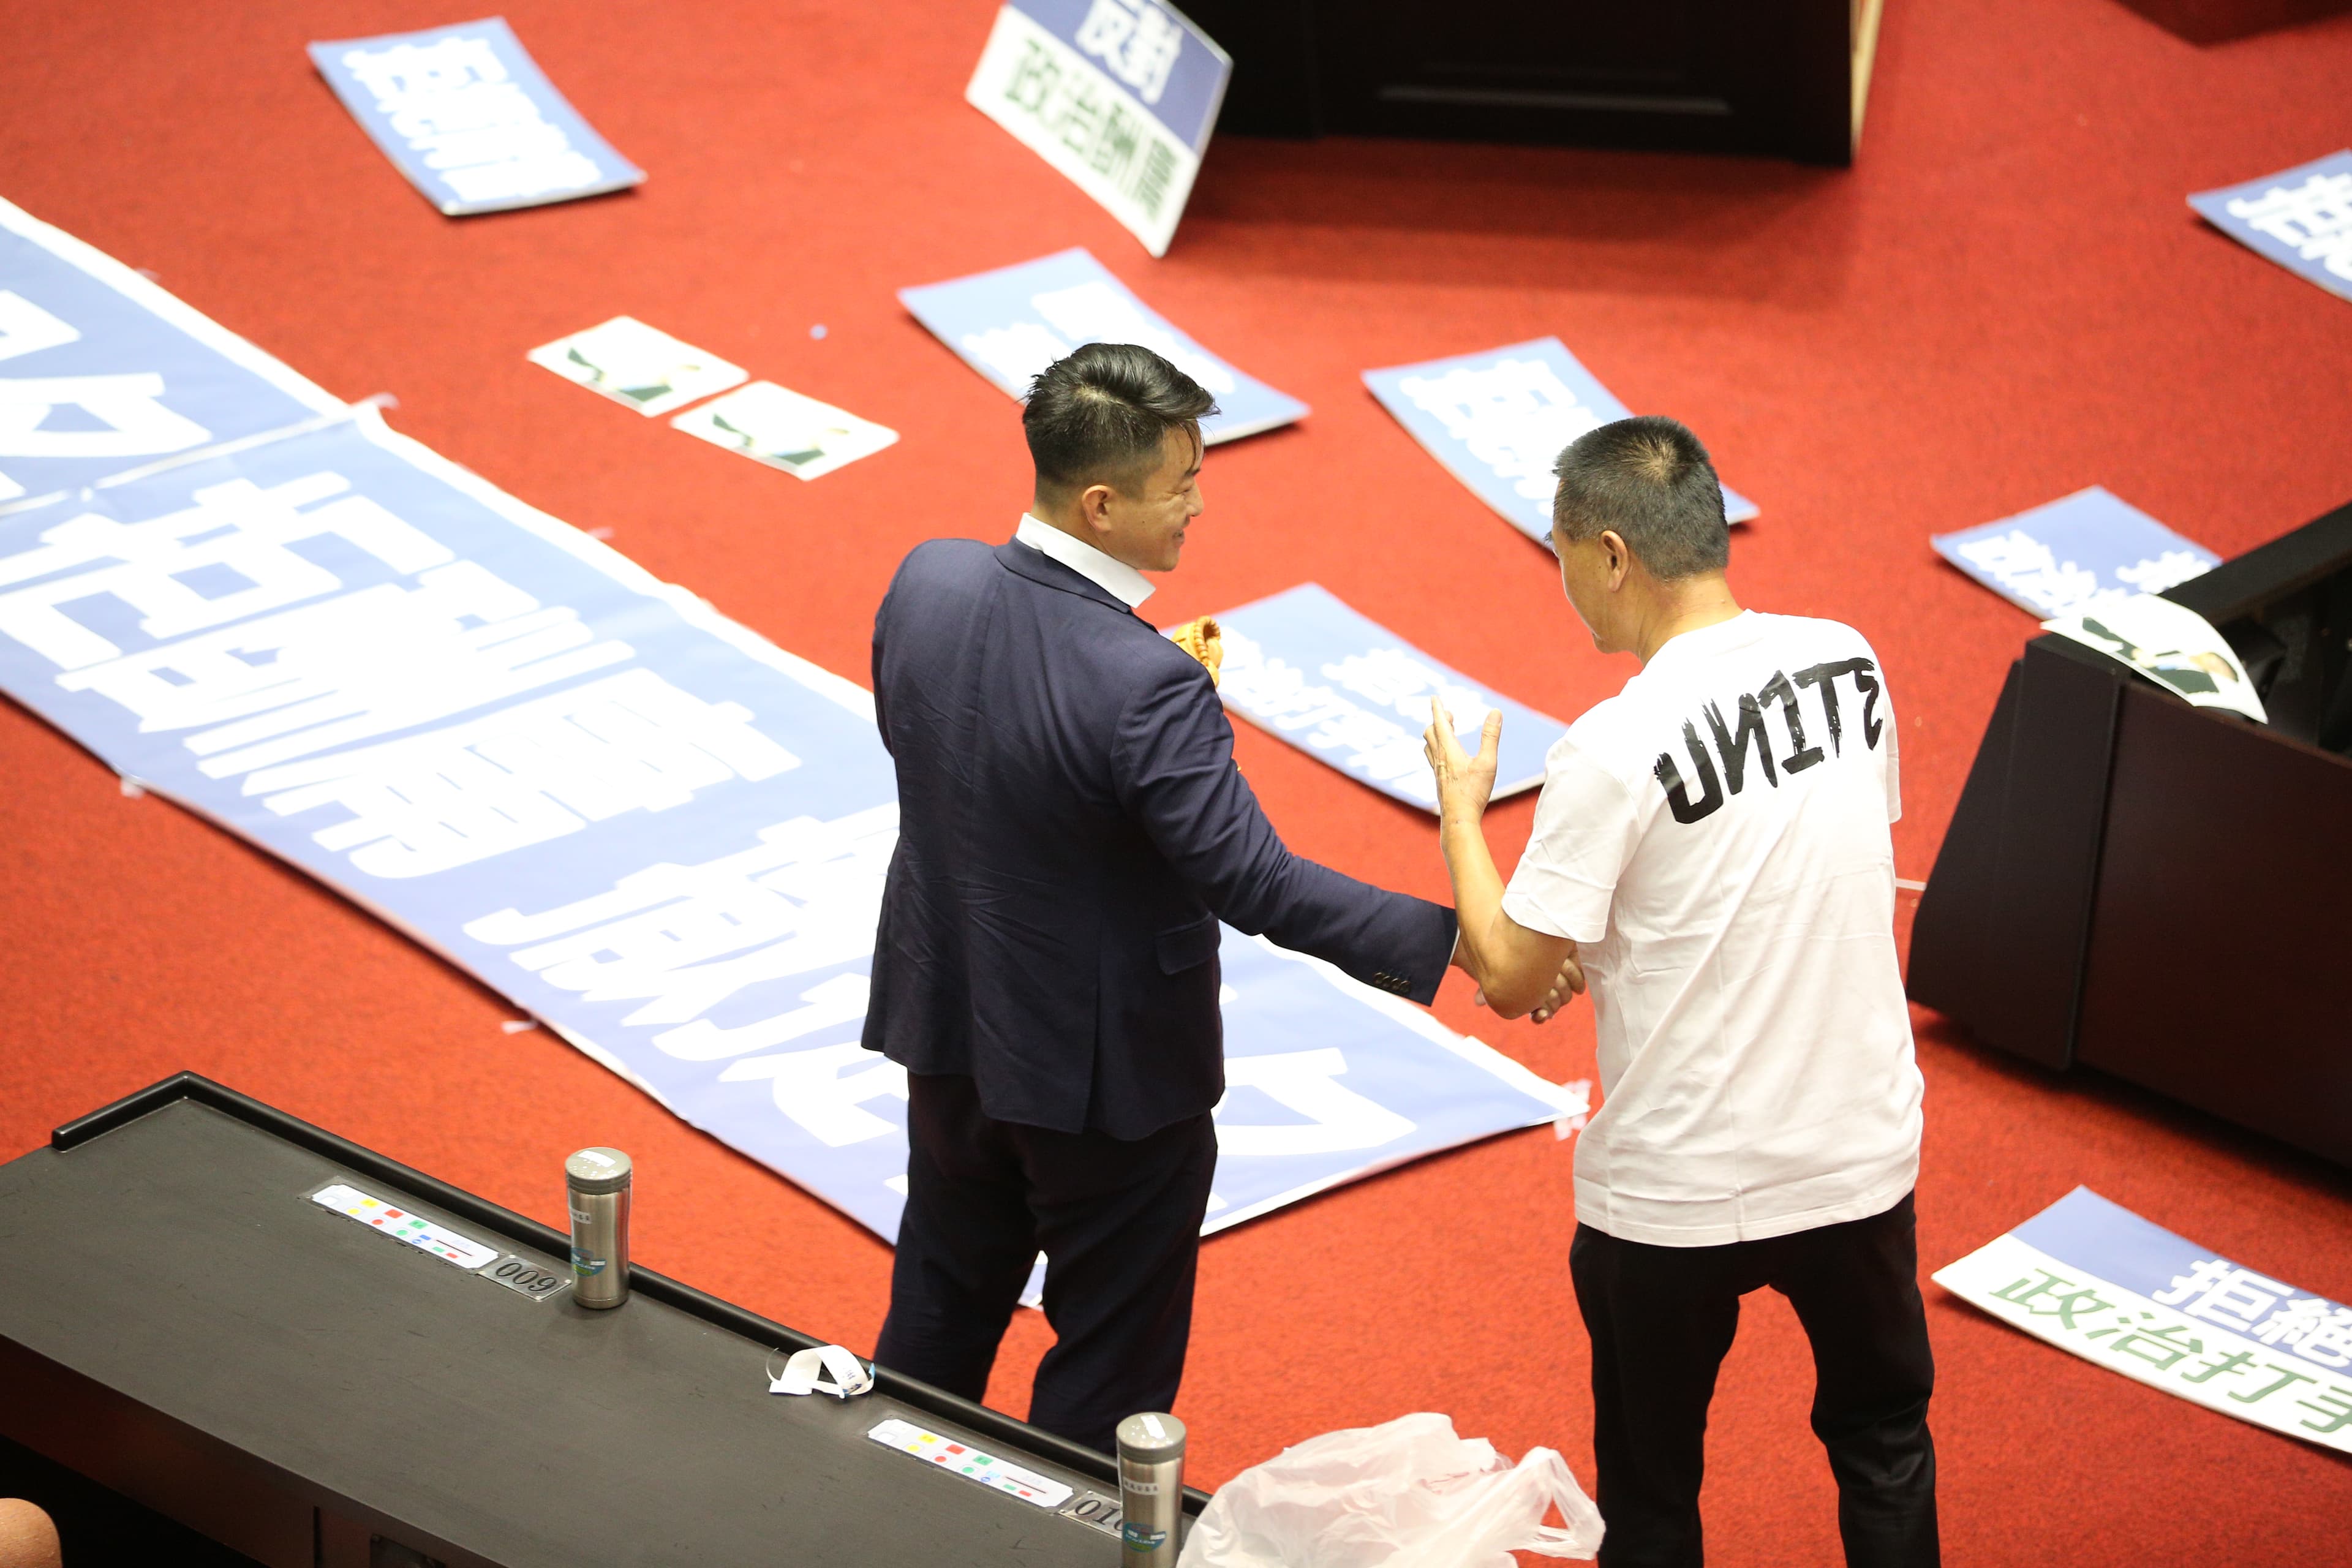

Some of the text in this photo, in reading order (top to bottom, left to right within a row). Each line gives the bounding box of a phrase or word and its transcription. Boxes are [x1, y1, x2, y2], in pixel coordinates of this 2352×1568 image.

[496, 1262, 557, 1292] 009
[2152, 1259, 2352, 1368] 拒絕
[1988, 1268, 2352, 1433] 政治打手
[1075, 1499, 1123, 1531] 01
